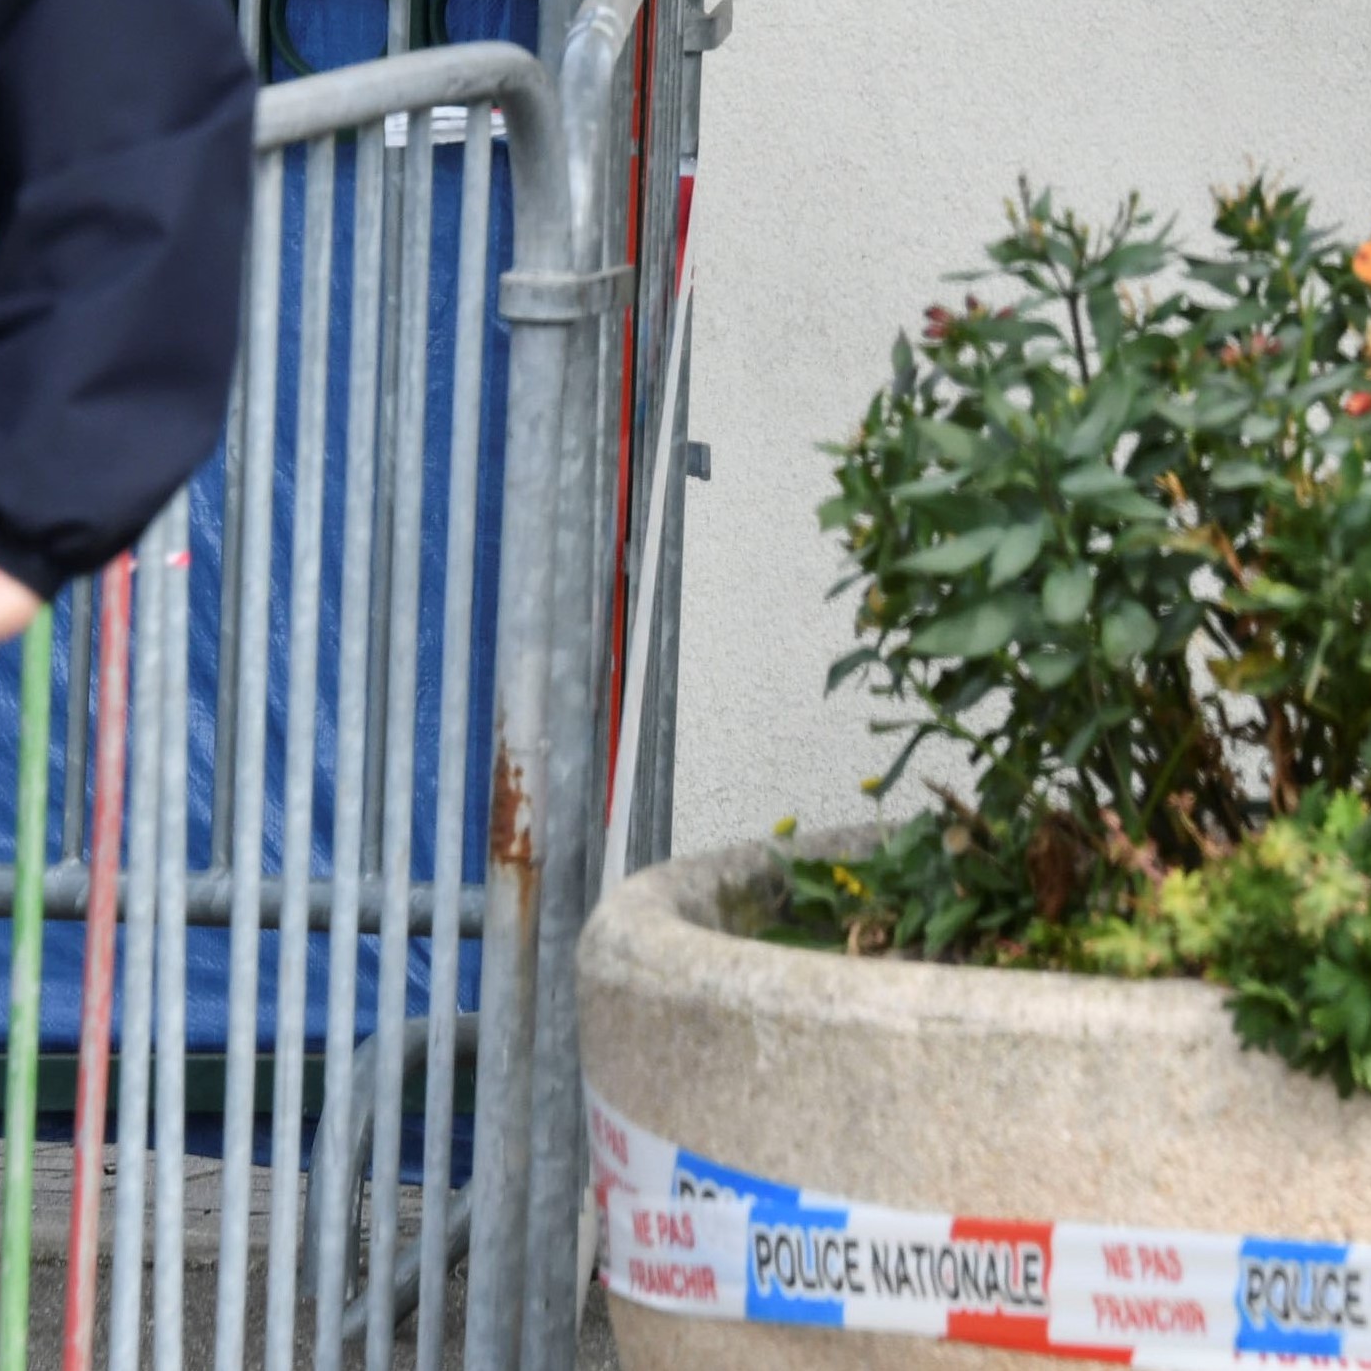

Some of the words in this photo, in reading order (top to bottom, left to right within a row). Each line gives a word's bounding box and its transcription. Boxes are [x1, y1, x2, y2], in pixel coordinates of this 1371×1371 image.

[657, 1212, 695, 1250] PAS
[629, 1258, 717, 1302] FRANCHIR
[755, 1232, 865, 1293] POLICE
[871, 1239, 1045, 1306] NATIONALE
[1103, 1242, 1133, 1281] NE
[1137, 1245, 1184, 1284] PAS
[1092, 1293, 1207, 1333] FRANCHIR
[1245, 1265, 1366, 1326] POLICE
